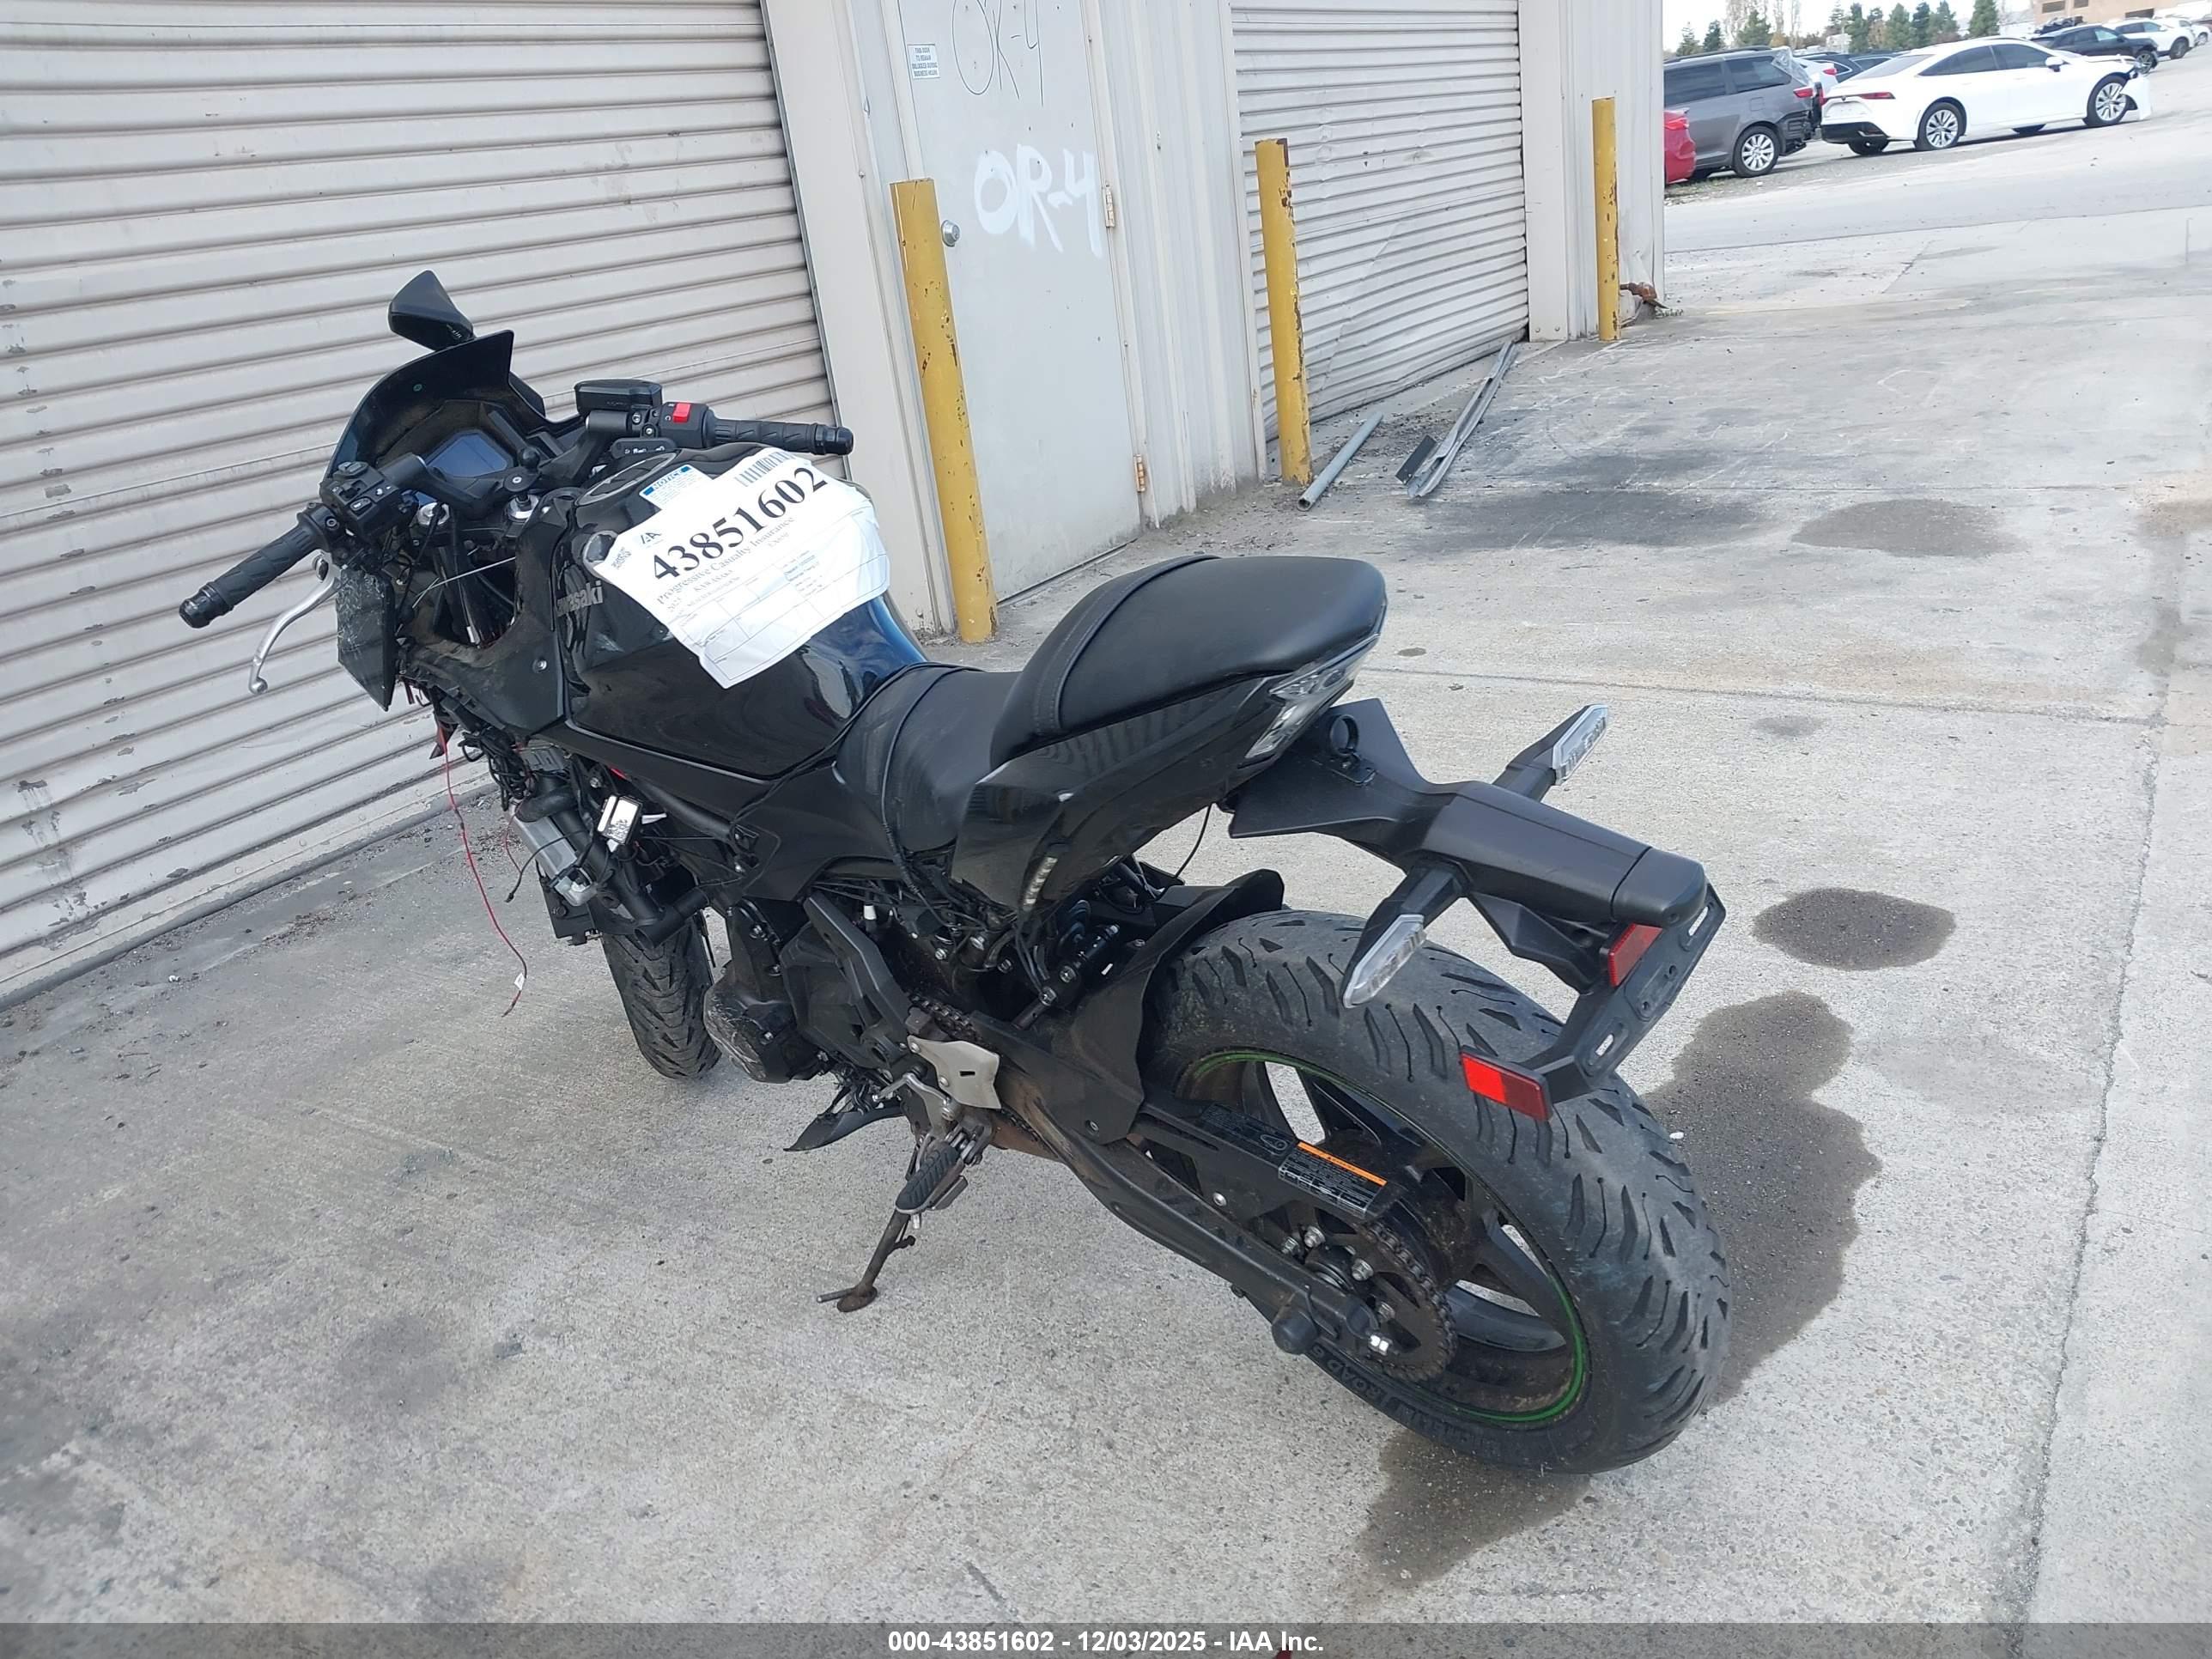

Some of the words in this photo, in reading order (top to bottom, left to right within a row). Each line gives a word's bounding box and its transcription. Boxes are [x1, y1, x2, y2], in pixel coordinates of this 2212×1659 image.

[974, 143, 1103, 258] OR-4
[653, 467, 829, 580] 43851602
[657, 568, 711, 605] Progressive
[710, 546, 751, 571] Casualty
[750, 517, 795, 547] Insurance
